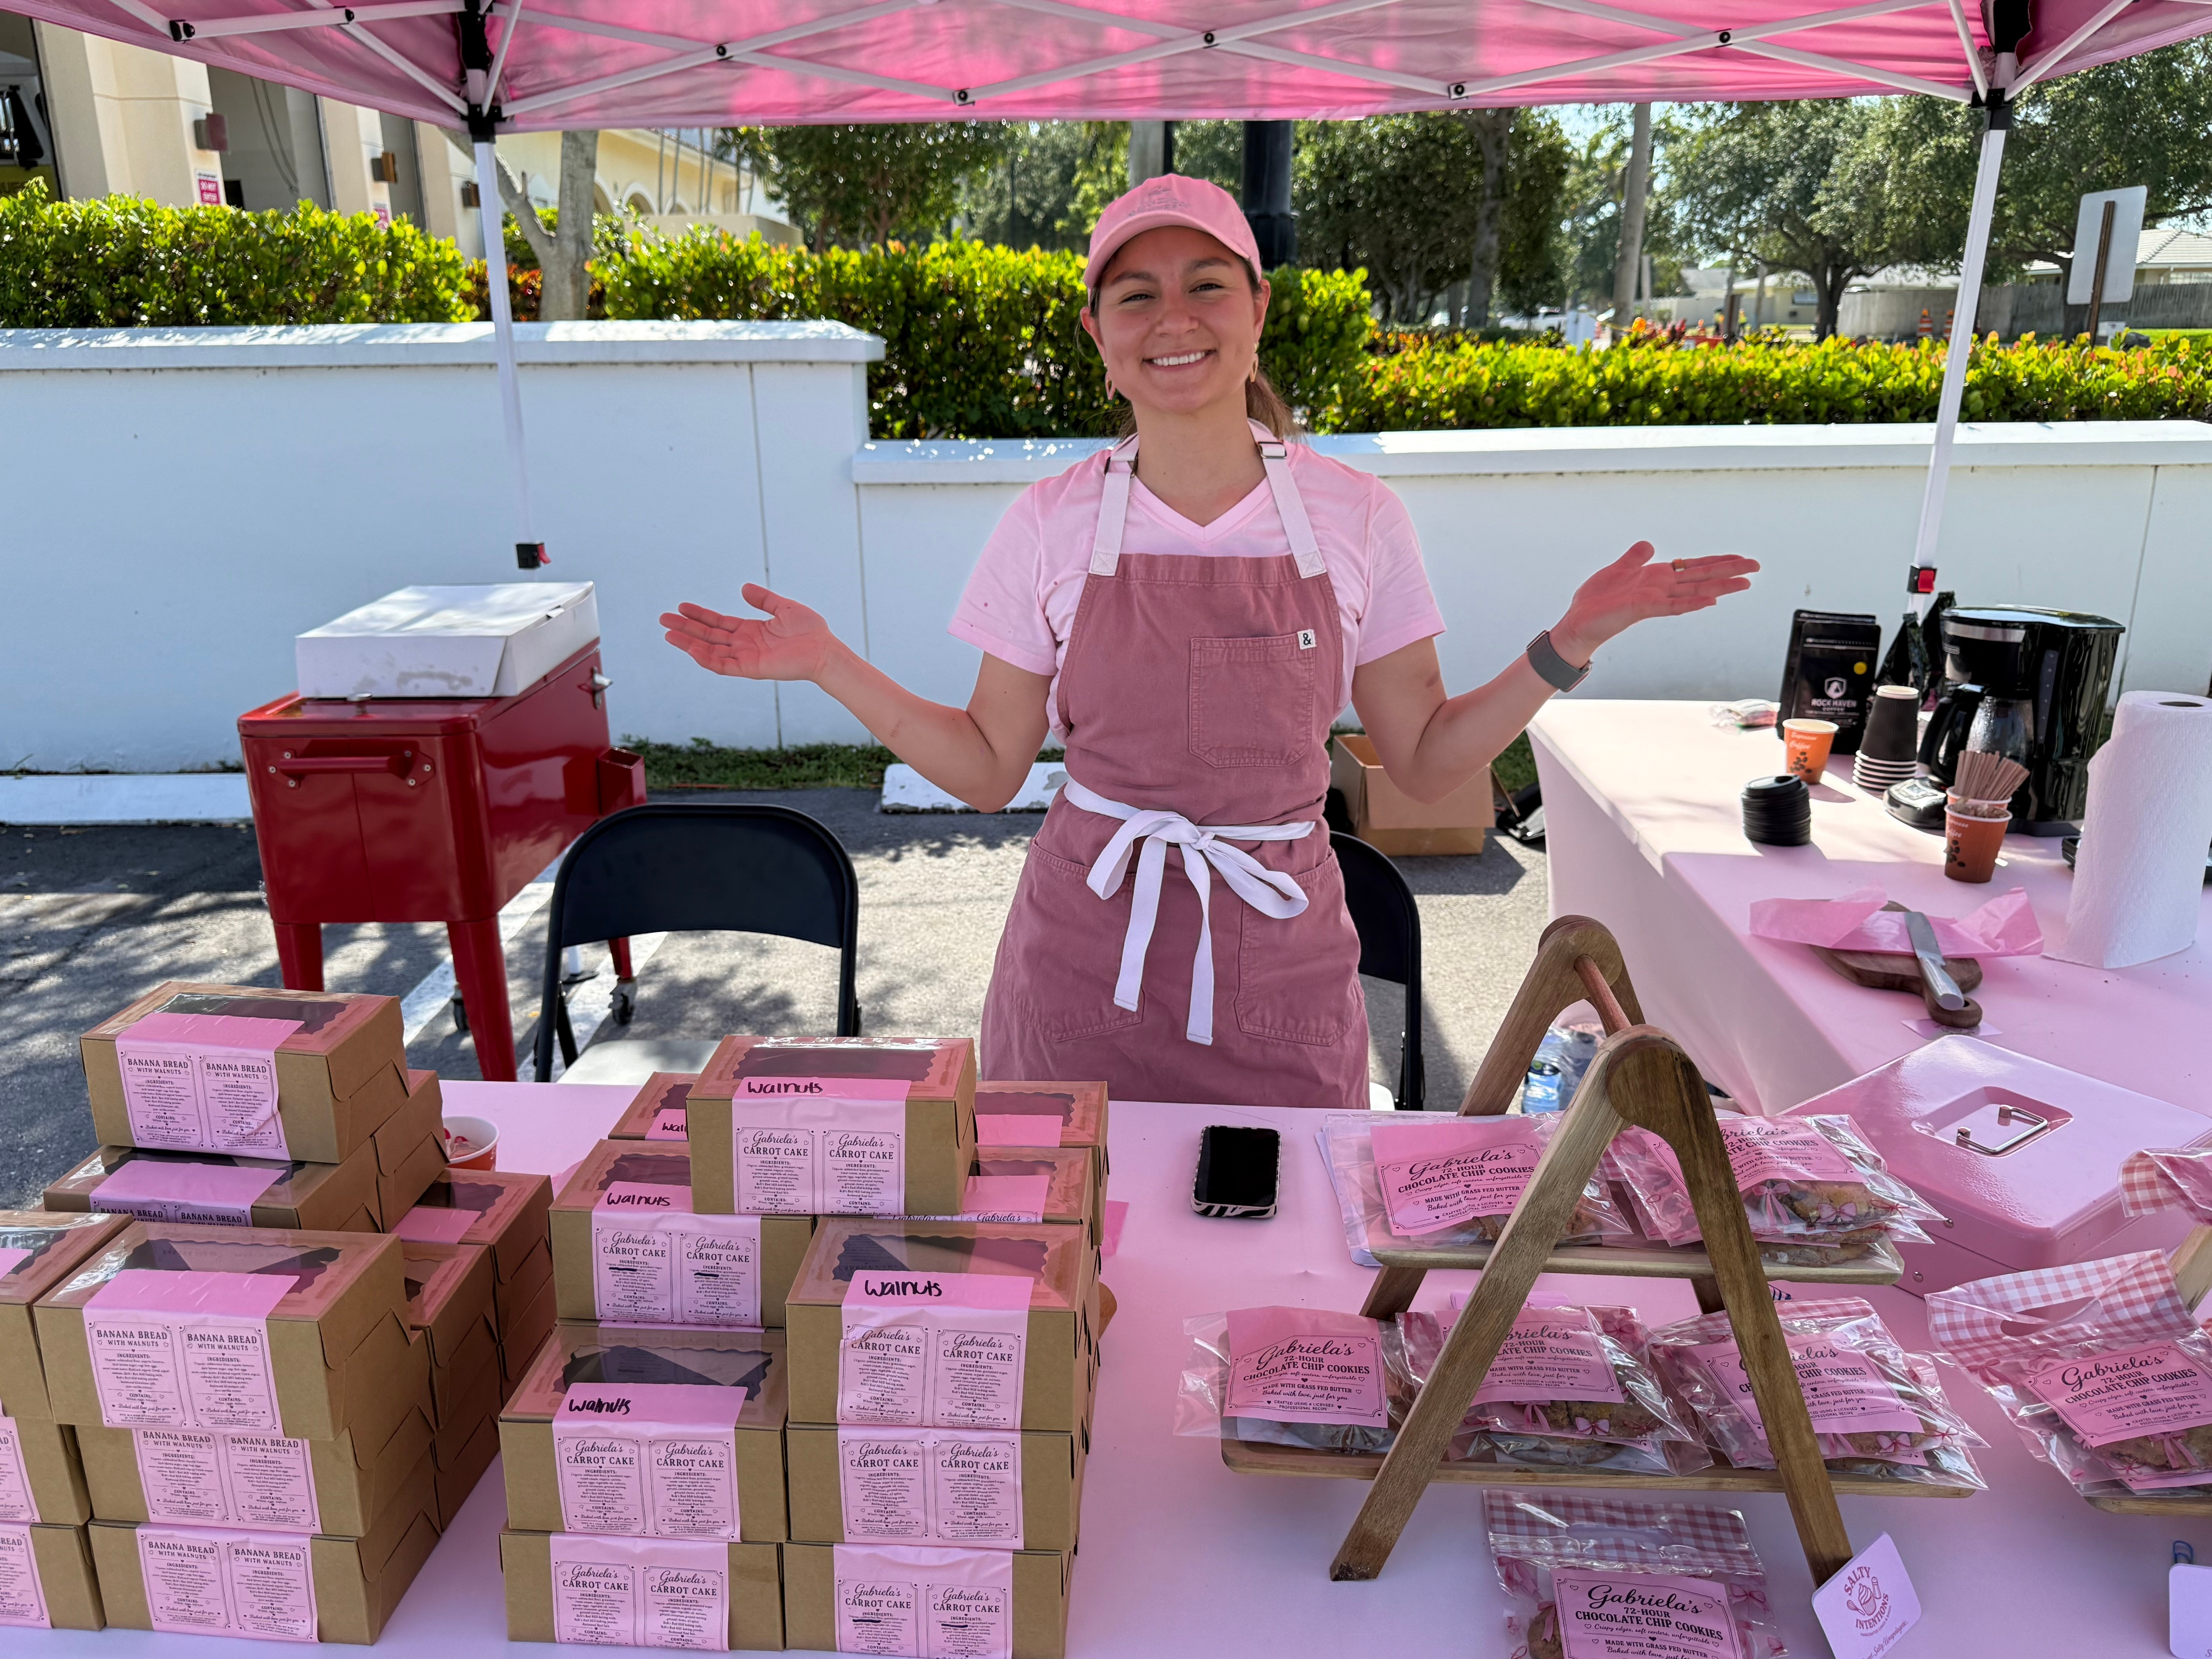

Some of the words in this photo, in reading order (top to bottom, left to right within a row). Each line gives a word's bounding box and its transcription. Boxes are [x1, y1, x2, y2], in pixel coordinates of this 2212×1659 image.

[1303, 633, 1311, 645] &
[1811, 699, 1830, 707] ROCK
[1832, 699, 1857, 708] HAVEN
[128, 1059, 160, 1067] BANANA
[163, 1060, 188, 1068] BREAD
[206, 1063, 238, 1071] BANANA
[752, 1131, 798, 1149] Gabriela's
[838, 1133, 884, 1151] Gabriela's
[744, 1147, 781, 1155] CARROT
[830, 1150, 866, 1158] CARROT
[1409, 1150, 1515, 1181] Gabriela's
[1441, 1164, 1484, 1173] 72-HOUR
[1398, 1172, 1458, 1193] CHOCOLATE
[181, 1212, 214, 1221] BANANA
[977, 1212, 1021, 1222] Gabriela's
[611, 1231, 656, 1249] Gabriela's
[694, 1237, 740, 1254] Gabriela's
[603, 1247, 639, 1255] CARROT
[643, 1249, 666, 1257] CAKE
[687, 1252, 723, 1261] CARROT
[726, 1254, 749, 1262] CAKE
[97, 1330, 134, 1338] BANANA
[138, 1331, 167, 1339] BREAD
[187, 1334, 225, 1342] BANANA
[228, 1335, 256, 1343] BREAD
[860, 1329, 911, 1343] Gabriela's
[852, 1342, 891, 1352] CARROT
[895, 1345, 920, 1354] CAKE
[952, 1334, 1003, 1351] Gabriela's
[943, 1350, 983, 1359] CARROT
[987, 1352, 1012, 1361] CAKE
[1256, 1340, 1354, 1370] Gabriela's
[1550, 1347, 1592, 1357] COOKIES
[1243, 1362, 1298, 1381] CHOCOLATE
[1302, 1362, 1324, 1370] CHIP
[1327, 1365, 1369, 1374] COOKIES
[1799, 1369, 1822, 1379] CHIP
[1824, 1367, 1867, 1376] COOKIES
[2061, 1356, 2164, 1393] Gabriela's
[2100, 1371, 2144, 1384] 72-HOUR
[2065, 1382, 2124, 1404] CHOCOLATE
[2126, 1377, 2150, 1388] CHIP
[2151, 1369, 2197, 1382] COOKIES
[143, 1431, 179, 1440] BANANA
[231, 1437, 267, 1446] BANANA
[271, 1439, 298, 1448] BREAD
[575, 1440, 623, 1458] Gabriela's
[665, 1442, 714, 1460] Gabriela's
[859, 1443, 908, 1462] Gabriela's
[950, 1443, 999, 1462] Gabriela's
[657, 1458, 695, 1467] CARROT
[851, 1459, 890, 1467] CARROT
[941, 1460, 980, 1469] CARROT
[984, 1462, 1008, 1470] CAKE
[149, 1542, 184, 1551] BANANA
[187, 1545, 214, 1553] BREAD
[235, 1549, 270, 1557] BANANA
[273, 1551, 301, 1560] BREAD
[570, 1565, 618, 1582] Gabriela's
[659, 1570, 706, 1587] Gabriela's
[563, 1580, 601, 1589] CARROT
[1844, 1566, 1870, 1596] SALTY
[651, 1585, 689, 1594] CARROT
[853, 1583, 900, 1601] Gabriela's
[941, 1588, 989, 1604] Gabriela's
[1588, 1585, 1702, 1614] Gabriela's
[846, 1598, 883, 1607] CARROT
[887, 1601, 911, 1609] CAKE
[934, 1603, 971, 1612] CARROT
[1624, 1607, 1671, 1618] 72-HOUR
[1855, 1593, 1889, 1630] INTENTIONS
[1576, 1611, 1643, 1625] CHOCOLATE
[1646, 1617, 1672, 1628] CHIP
[1675, 1621, 1723, 1641] COOKIES
[1672, 1633, 1709, 1644] unforgettable
[1683, 1648, 1708, 1658] BUTTER
